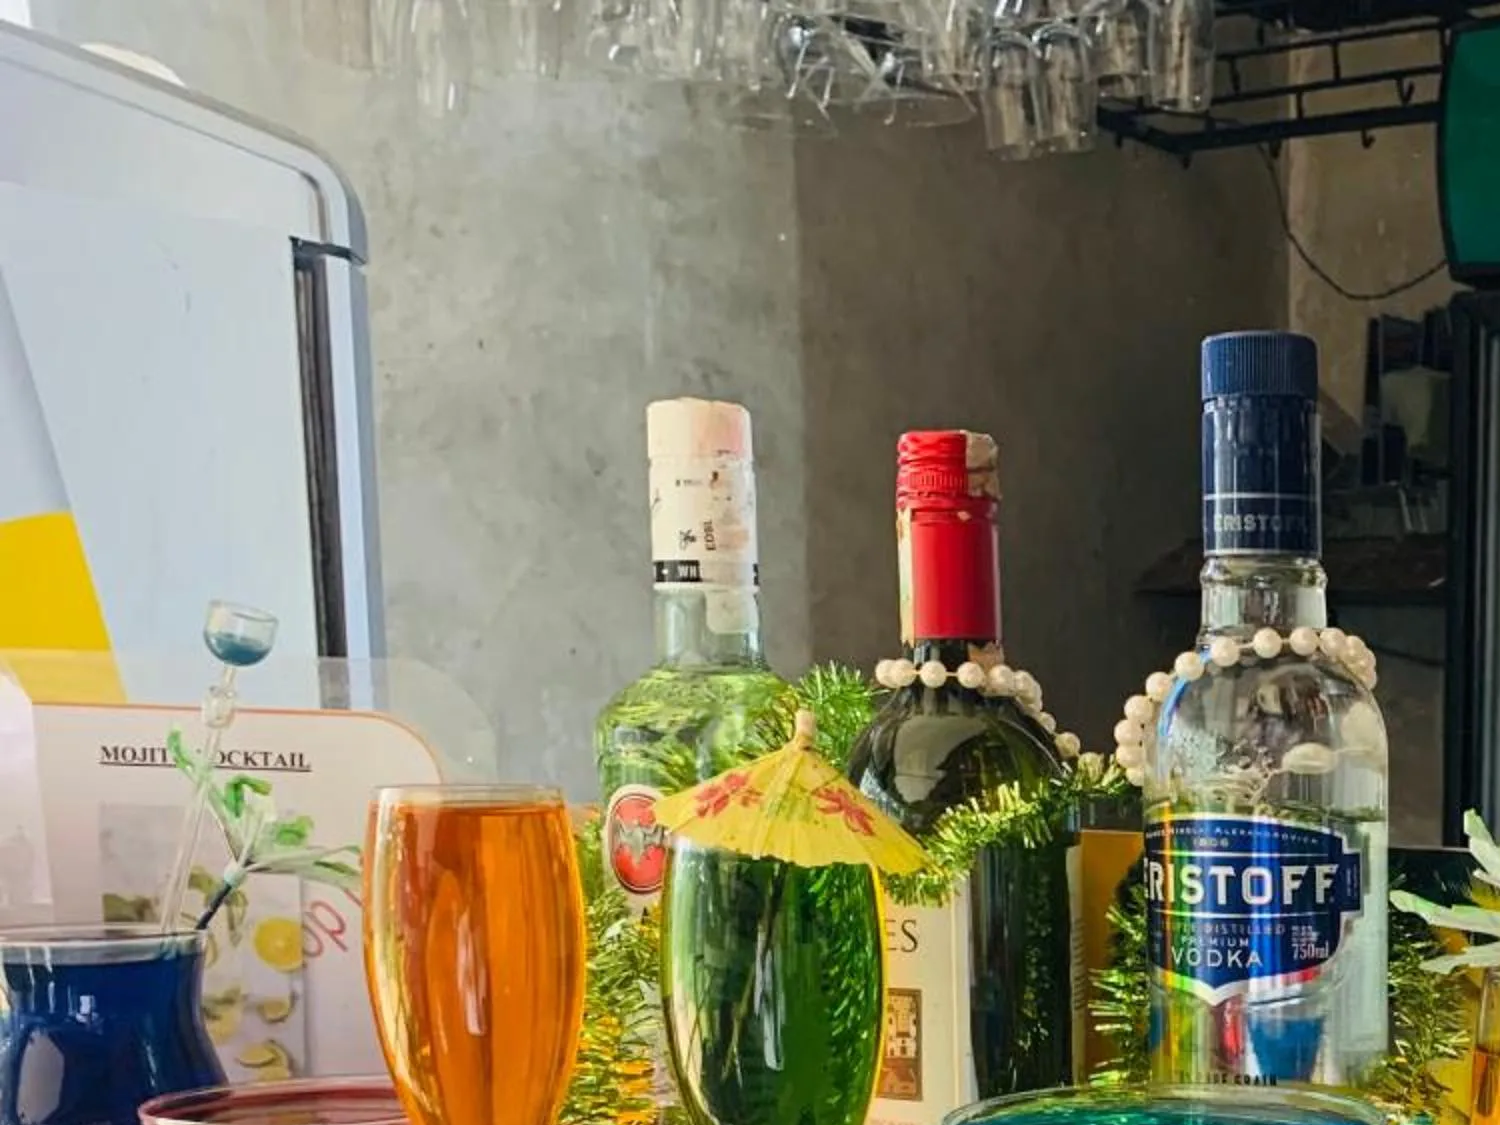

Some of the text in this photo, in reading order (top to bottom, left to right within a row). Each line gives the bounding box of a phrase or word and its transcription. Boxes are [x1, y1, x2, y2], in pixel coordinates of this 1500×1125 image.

[100, 745, 311, 769] MOJIT CKTAIL
[1171, 946, 1264, 969] VODKA
